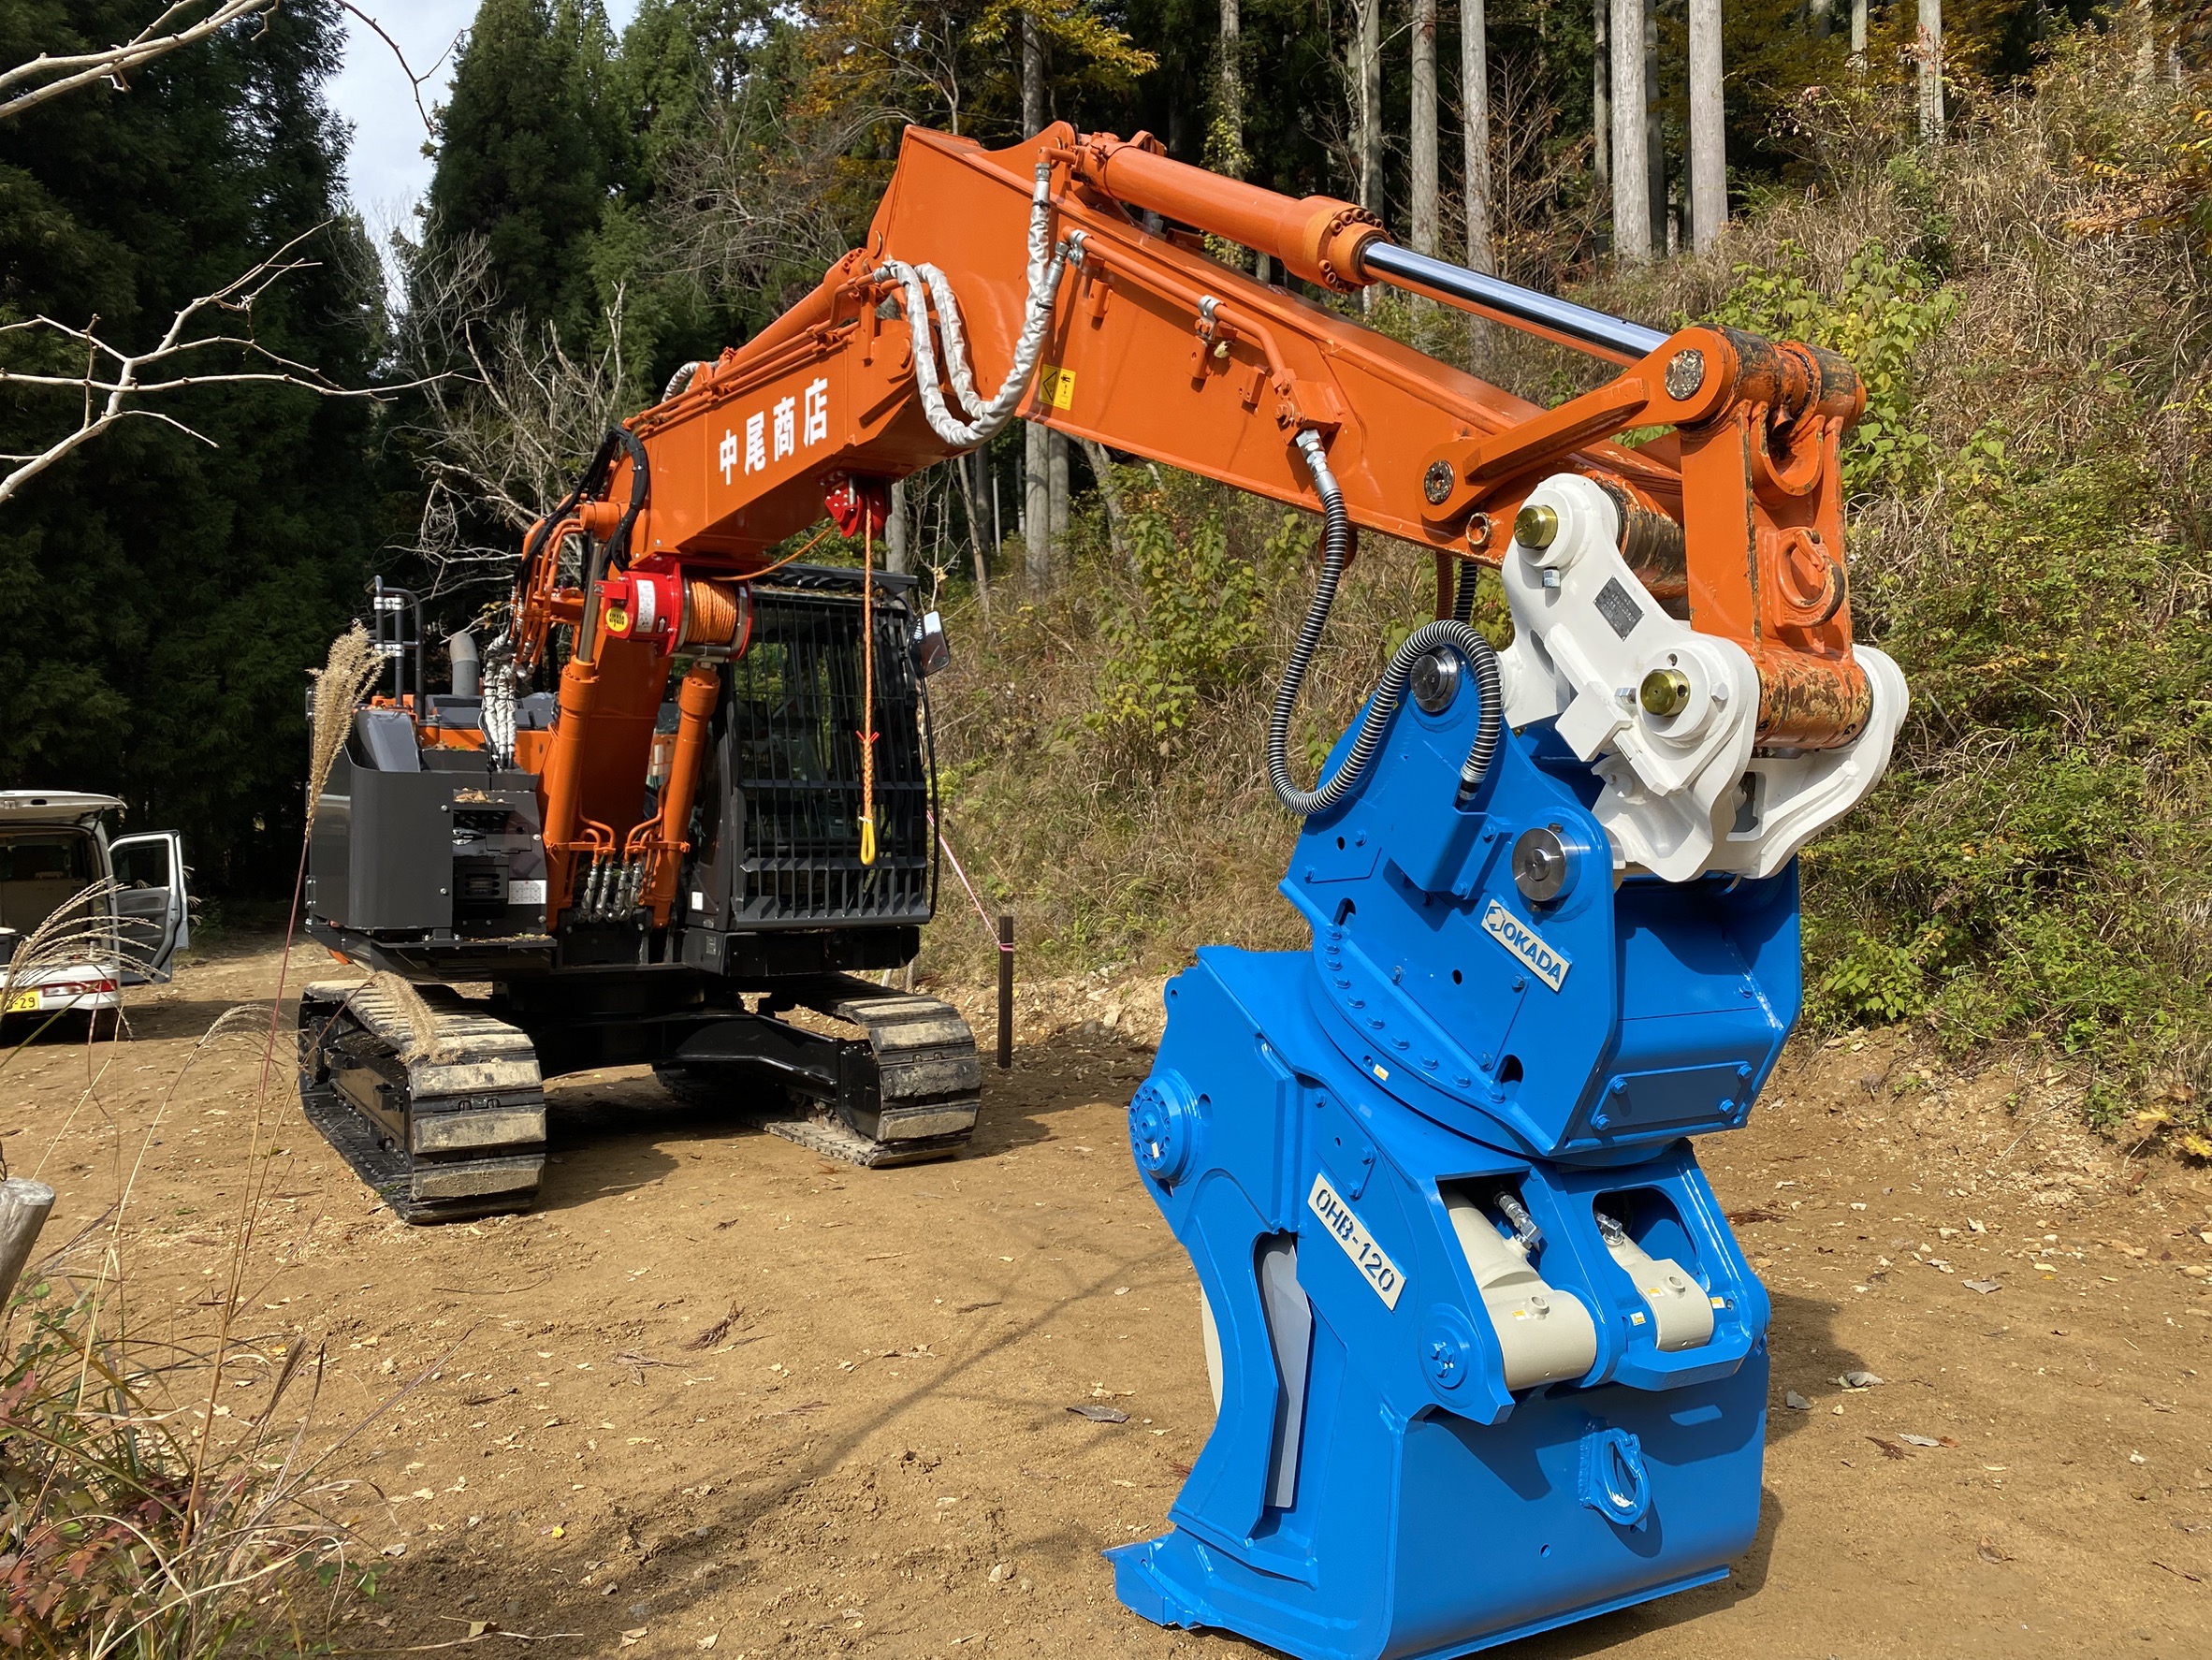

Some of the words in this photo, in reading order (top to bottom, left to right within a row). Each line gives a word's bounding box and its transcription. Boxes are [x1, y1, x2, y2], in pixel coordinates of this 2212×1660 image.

[720, 377, 828, 486] 中尾商店
[1503, 922, 1562, 985] OKADA
[1316, 1188, 1395, 1292] OHB-120
